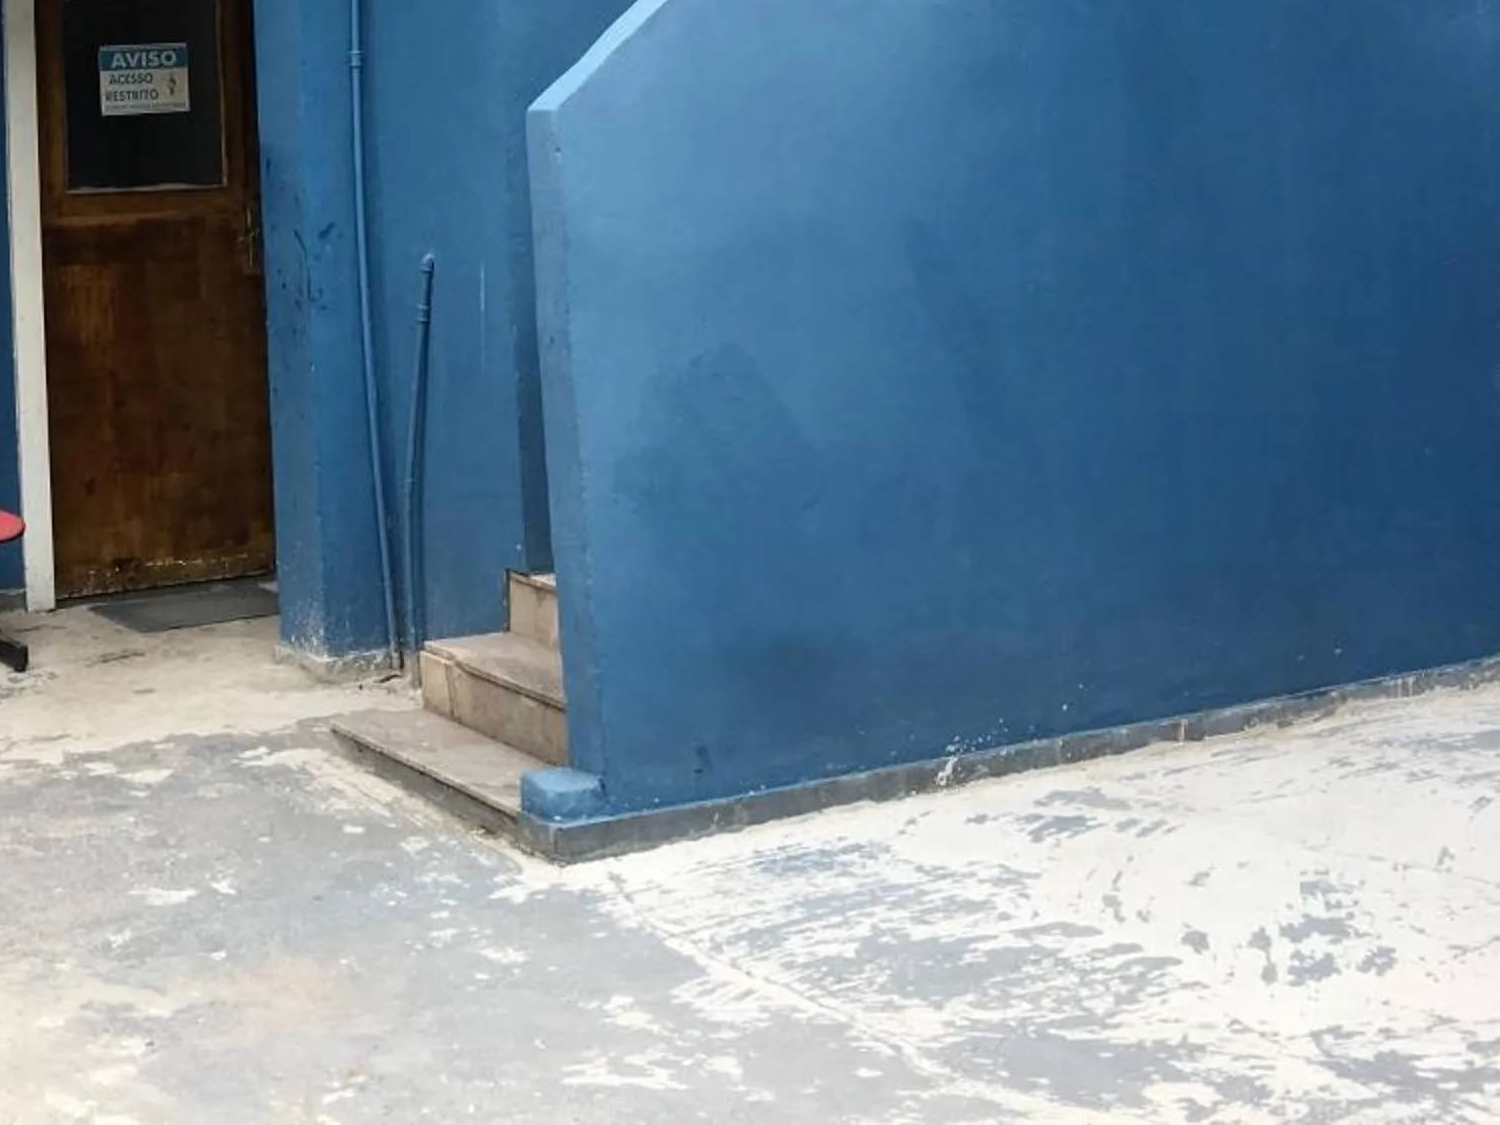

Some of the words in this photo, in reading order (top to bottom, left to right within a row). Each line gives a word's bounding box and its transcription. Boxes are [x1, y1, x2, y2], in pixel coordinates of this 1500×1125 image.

[111, 50, 177, 68] AVISO
[108, 72, 154, 86] ACESSO
[105, 88, 160, 102] RESTRITO
